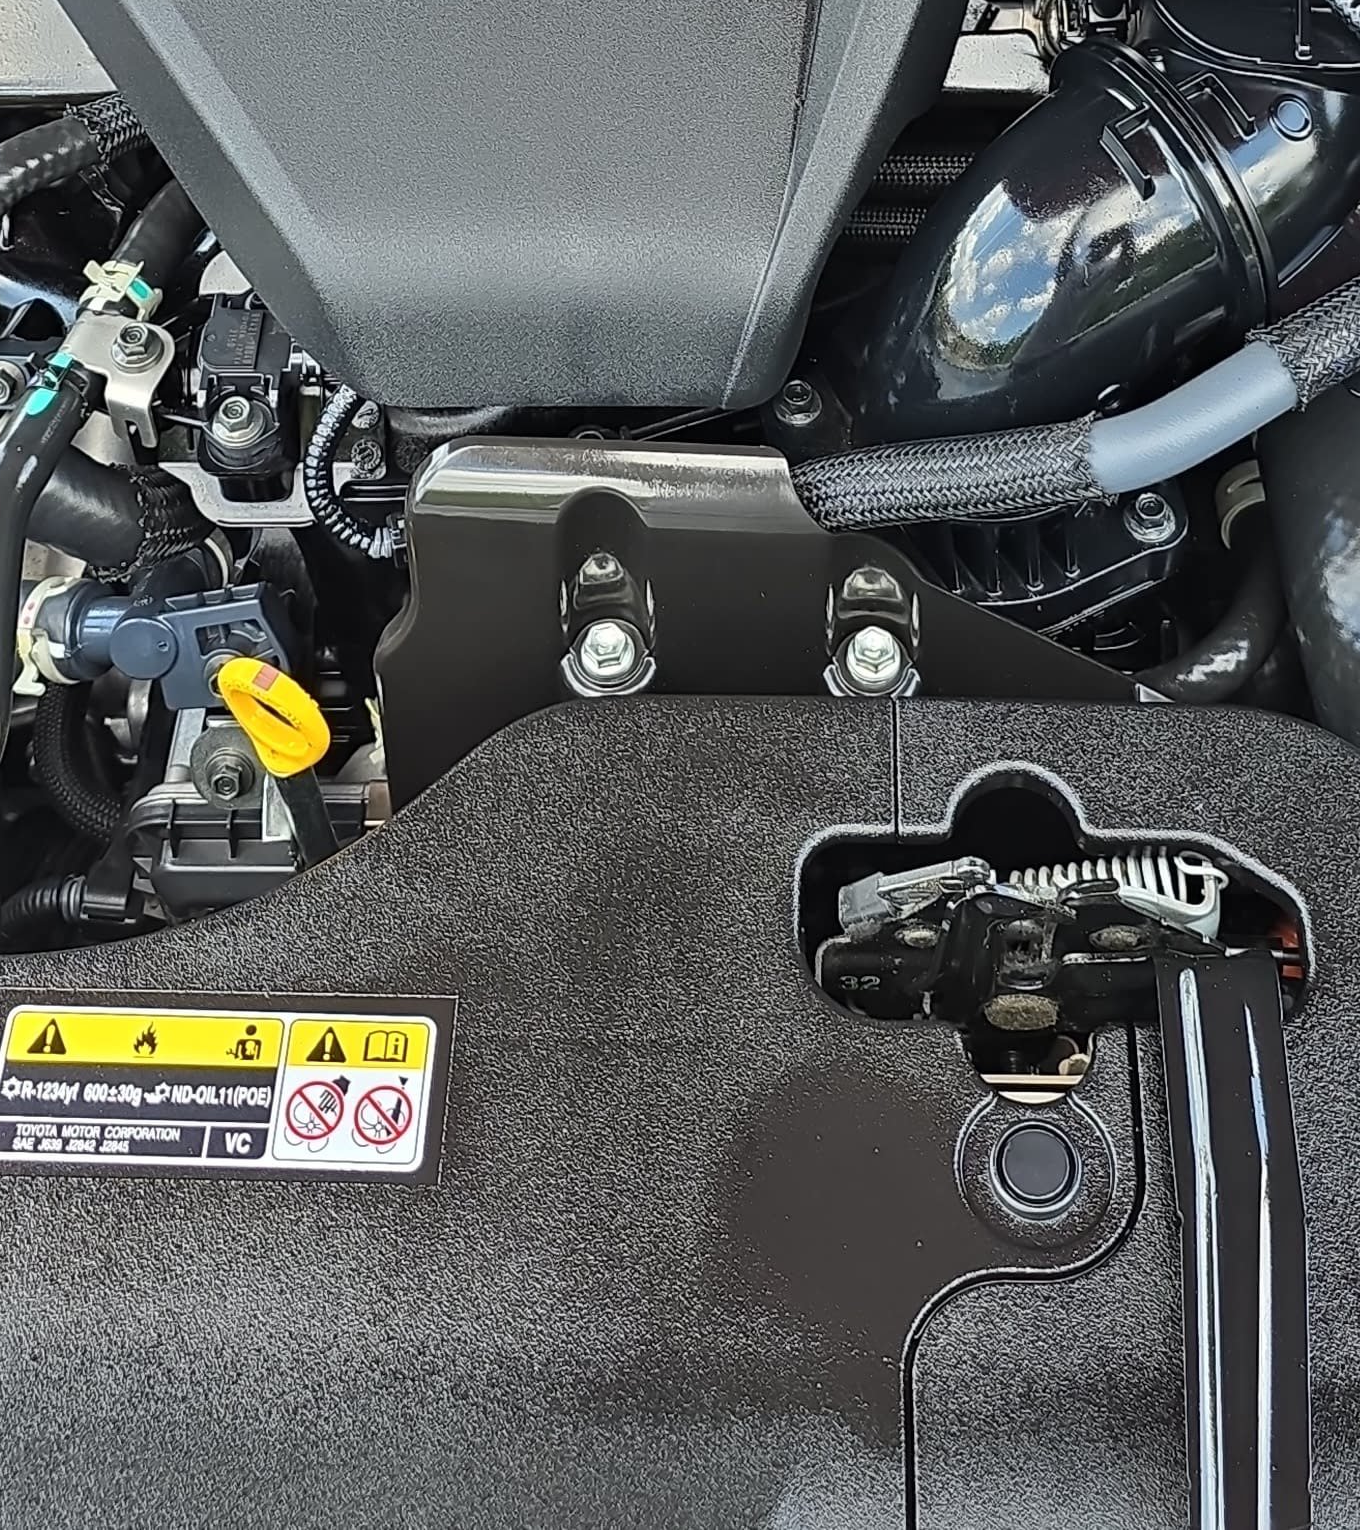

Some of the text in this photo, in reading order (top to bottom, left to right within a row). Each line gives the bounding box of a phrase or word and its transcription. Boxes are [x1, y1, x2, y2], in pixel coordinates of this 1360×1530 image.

[840, 975, 880, 990] 32
[20, 1082, 272, 1108] R-1234yf 600±30g ND-OIL11(POE)
[15, 1123, 181, 1141] TOYOTA MOTOR CORPORATION
[12, 1137, 34, 1150] SAE
[37, 1138, 62, 1151] J639
[224, 1131, 252, 1154] VC
